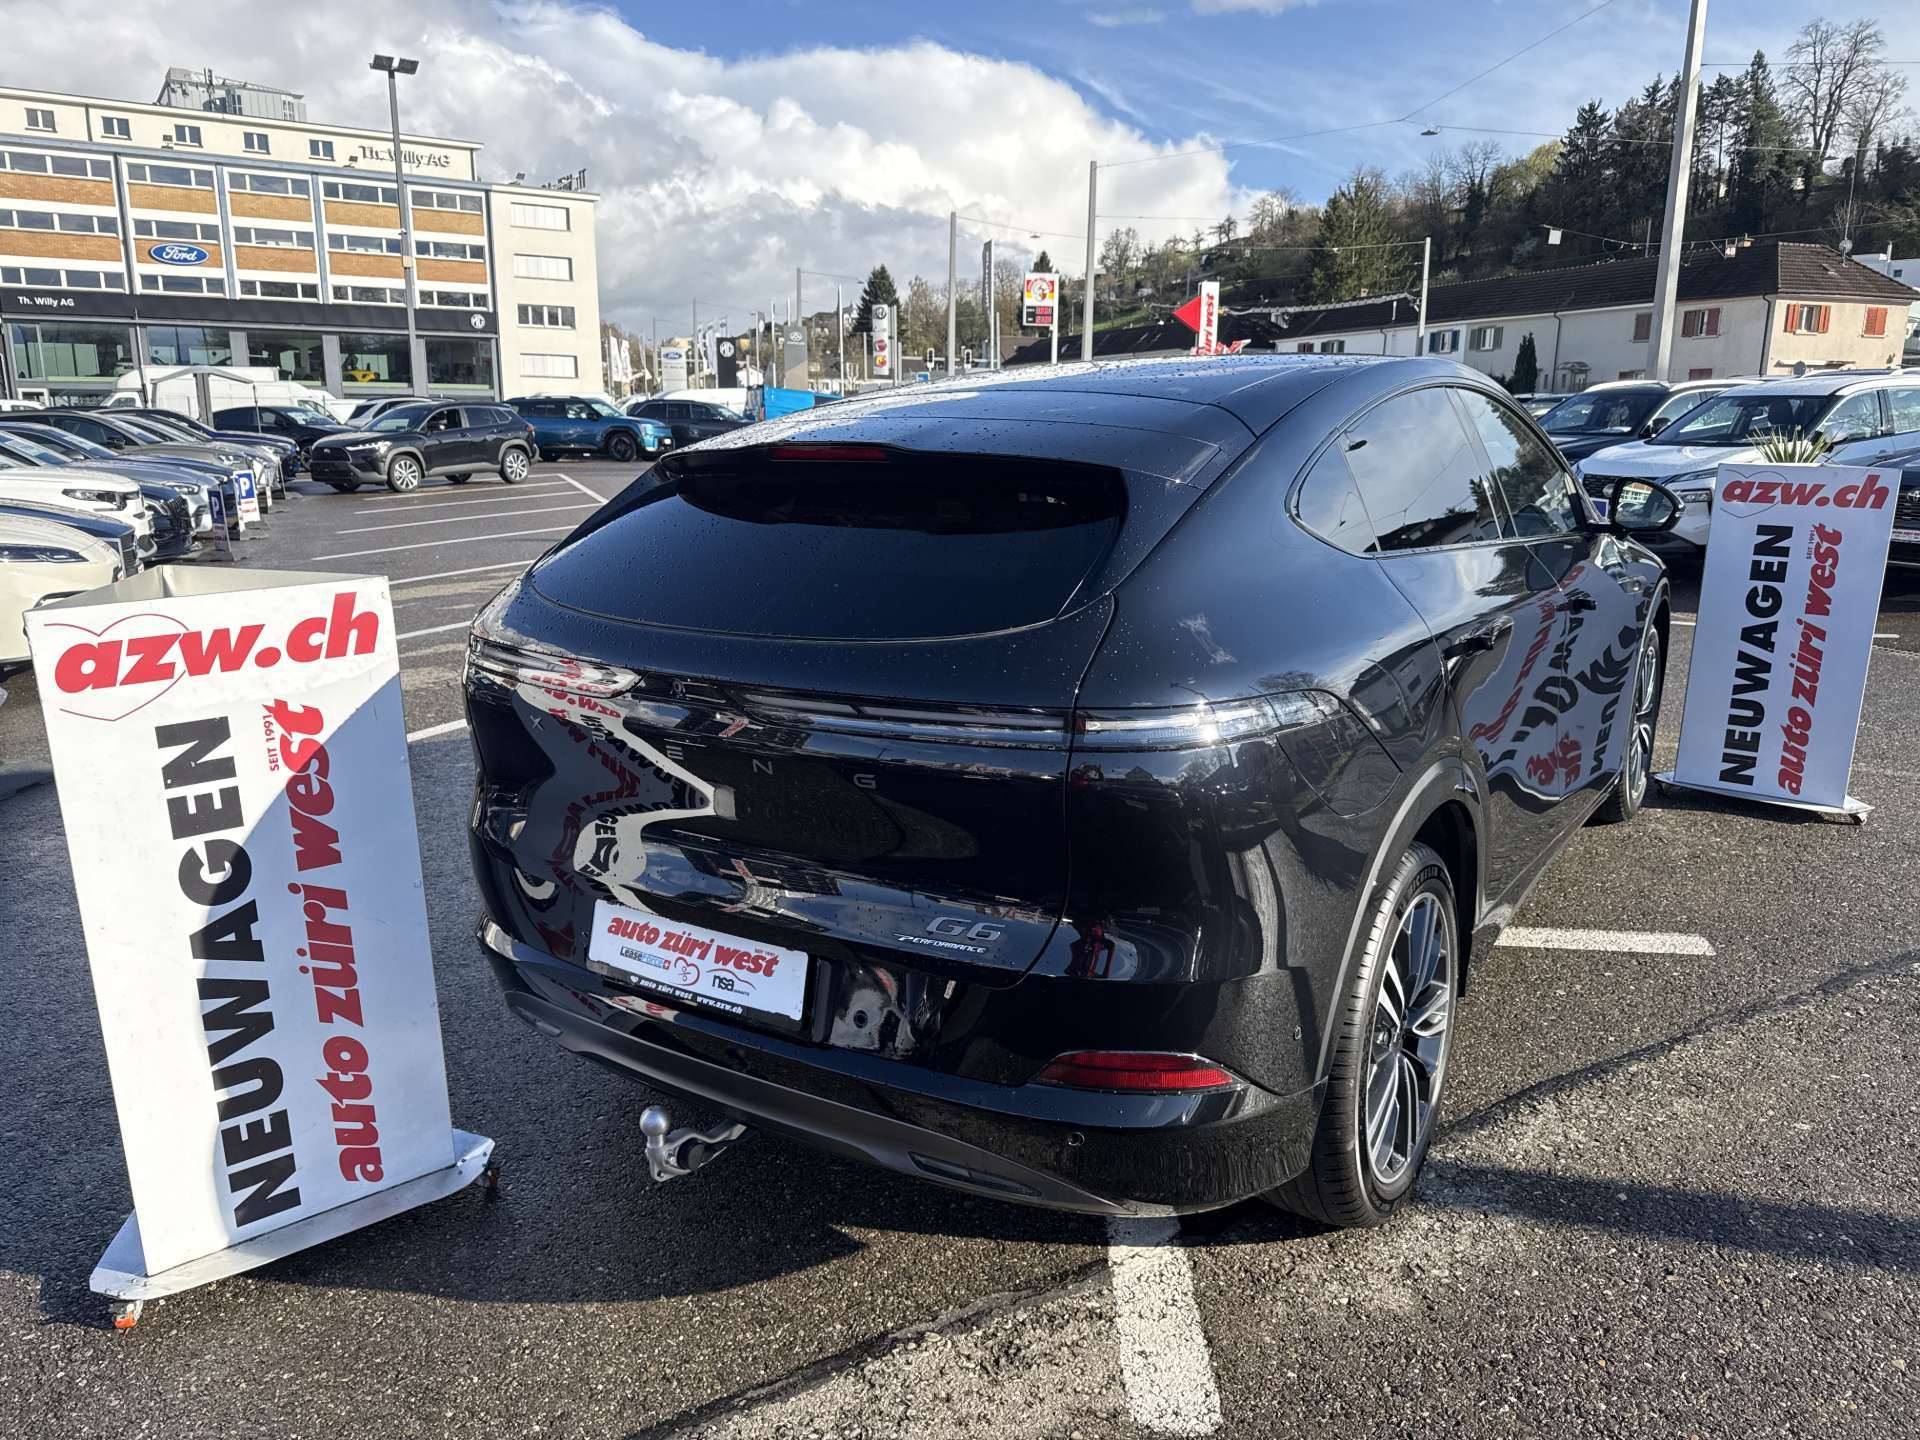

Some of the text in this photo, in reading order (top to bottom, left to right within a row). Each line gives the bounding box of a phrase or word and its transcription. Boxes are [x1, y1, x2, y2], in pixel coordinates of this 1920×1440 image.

[427, 153, 450, 167] AG
[162, 245, 197, 261] Ford
[17, 296, 75, 307] Th. Willy AG
[1722, 474, 1889, 509] azw.ch
[55, 591, 379, 694] azw.ch
[1719, 524, 1793, 786] NEUWAGEN
[1778, 522, 1843, 796] auto züri west
[263, 714, 280, 772] SEIT 1991
[262, 698, 384, 1183] auto züri west
[894, 933, 987, 954] PERFORMANCE
[926, 916, 1006, 941] G6
[607, 916, 780, 977] auto züri west
[155, 716, 302, 1228] NEUWAGEN
[640, 979, 657, 989] auto
[675, 989, 693, 1000] west
[712, 975, 735, 992] nsa
